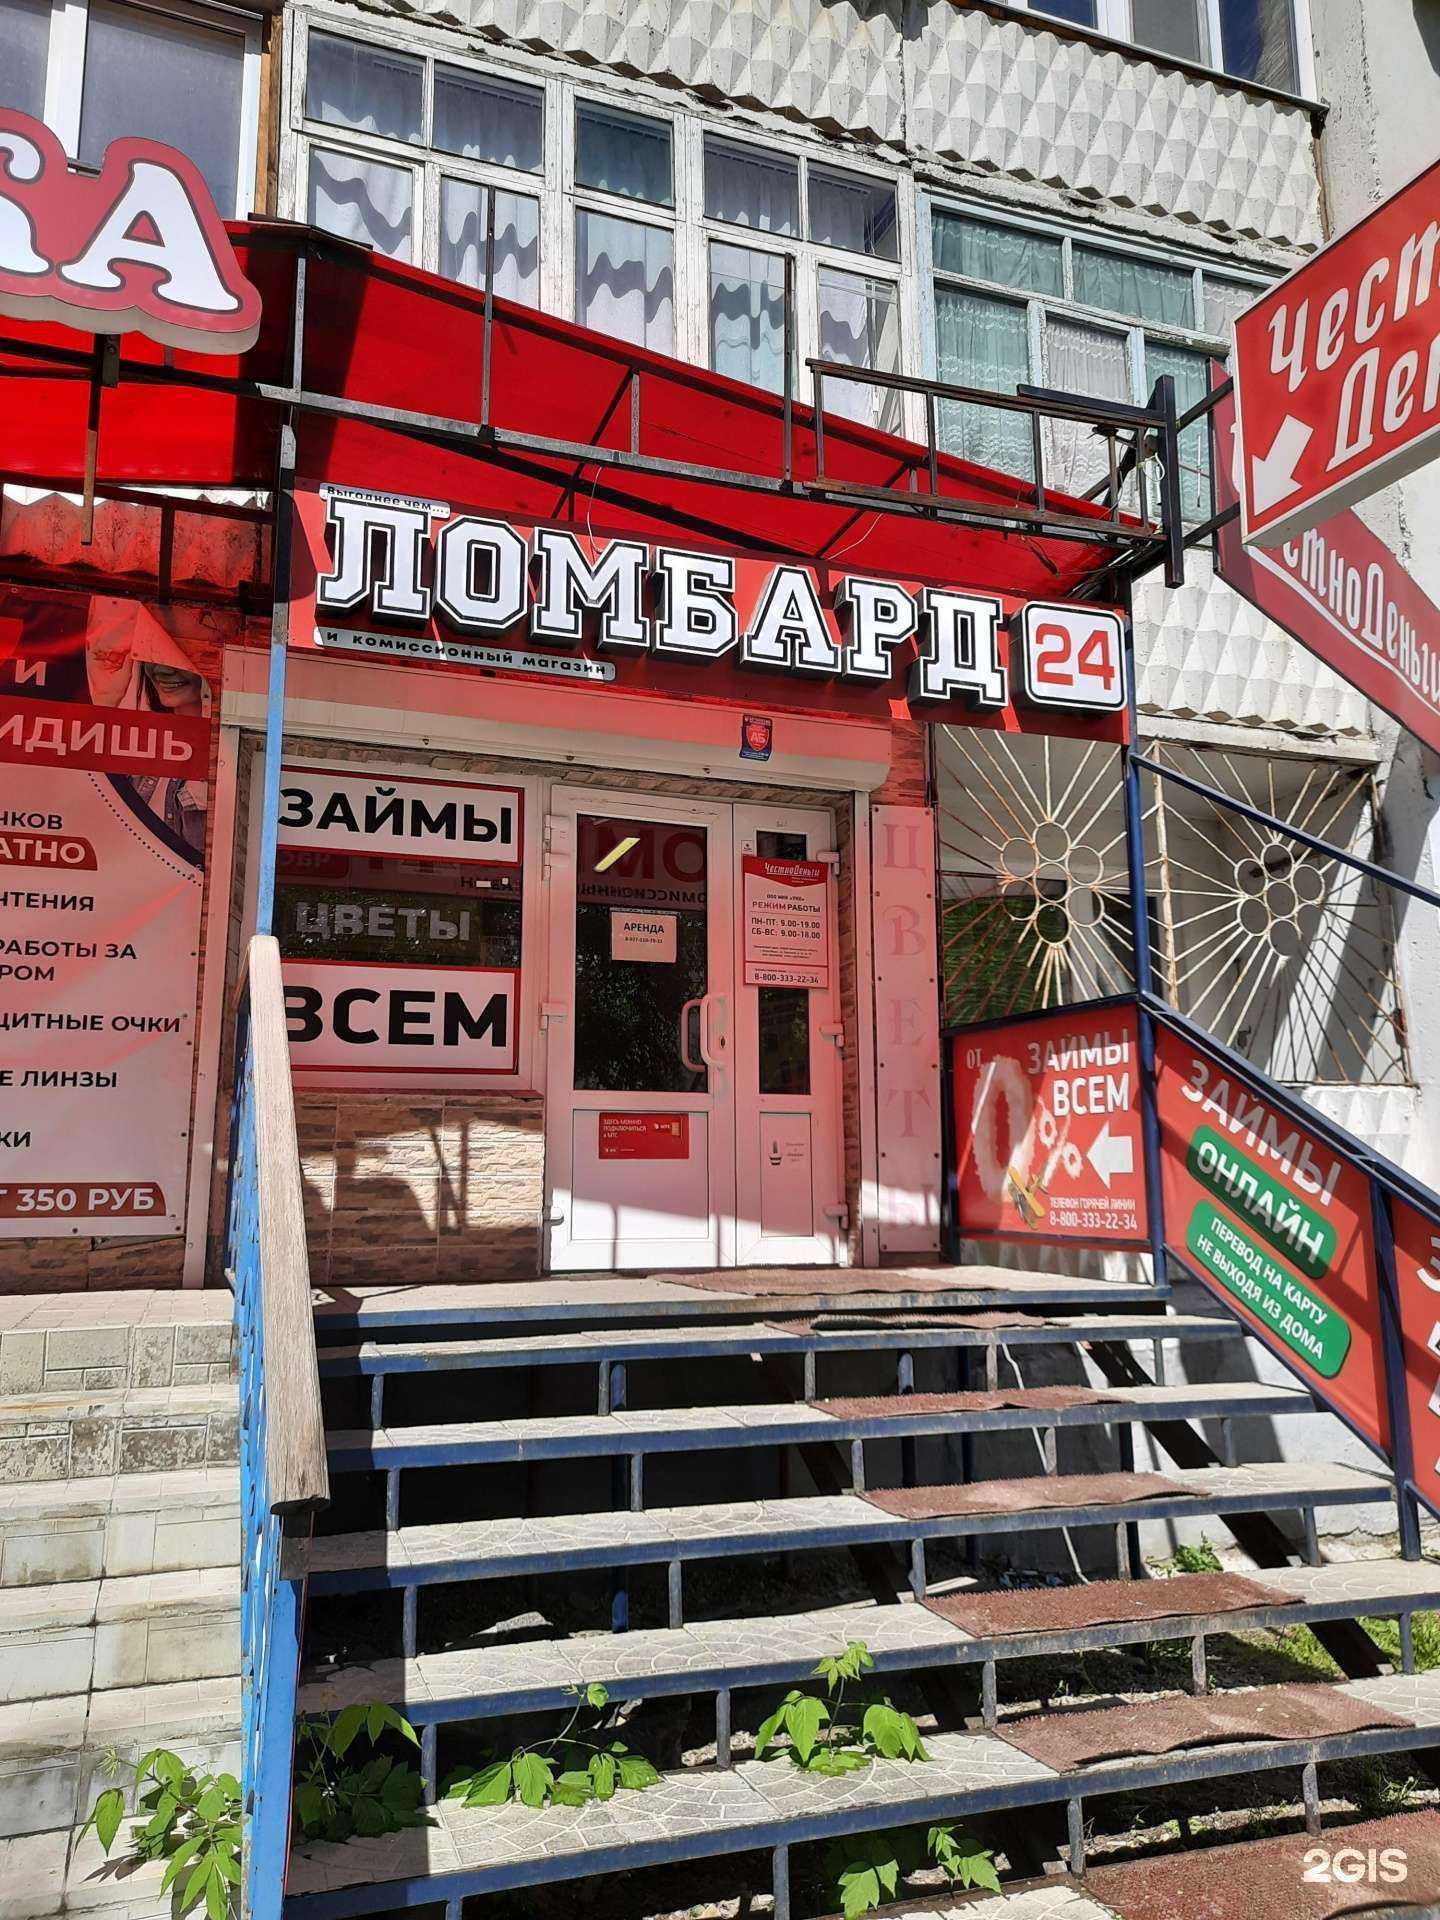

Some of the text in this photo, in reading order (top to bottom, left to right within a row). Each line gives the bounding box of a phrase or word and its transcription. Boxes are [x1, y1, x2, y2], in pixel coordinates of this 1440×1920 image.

[315, 496, 1117, 707] ЛОМБАРД 24
[326, 632, 606, 676] и комиссионный магазин
[278, 785, 513, 845] ЗАЙМЫ
[295, 901, 471, 941] ЦВЕТЫ
[623, 922, 665, 935] АРЕНДА
[752, 901, 821, 912] РЕЖИМ РАБОТЫ
[104, 943, 138, 960] ЗА
[111, 1015, 181, 1033] ОЧКИ
[282, 984, 508, 1048] ВСЕМ
[1026, 1028, 1130, 1075] ЗАЙМЫ
[20, 1070, 118, 1088] ЛИНЗЫ
[1052, 1072, 1130, 1117] ВСЕМ
[1181, 1059, 1342, 1207] ЗАЙМЫ
[15, 1187, 78, 1212] 350
[87, 1187, 155, 1211] РУБ
[1049, 1210, 1138, 1231] 8-800-333-22-34
[1196, 1141, 1325, 1264] ОНЛАЙН
[1210, 1217, 1328, 1325] ПЕРЕВОД НА КАРТУ
[1196, 1233, 1325, 1360] НЕ ВЫХОДЯ ИЗ ДОМА
